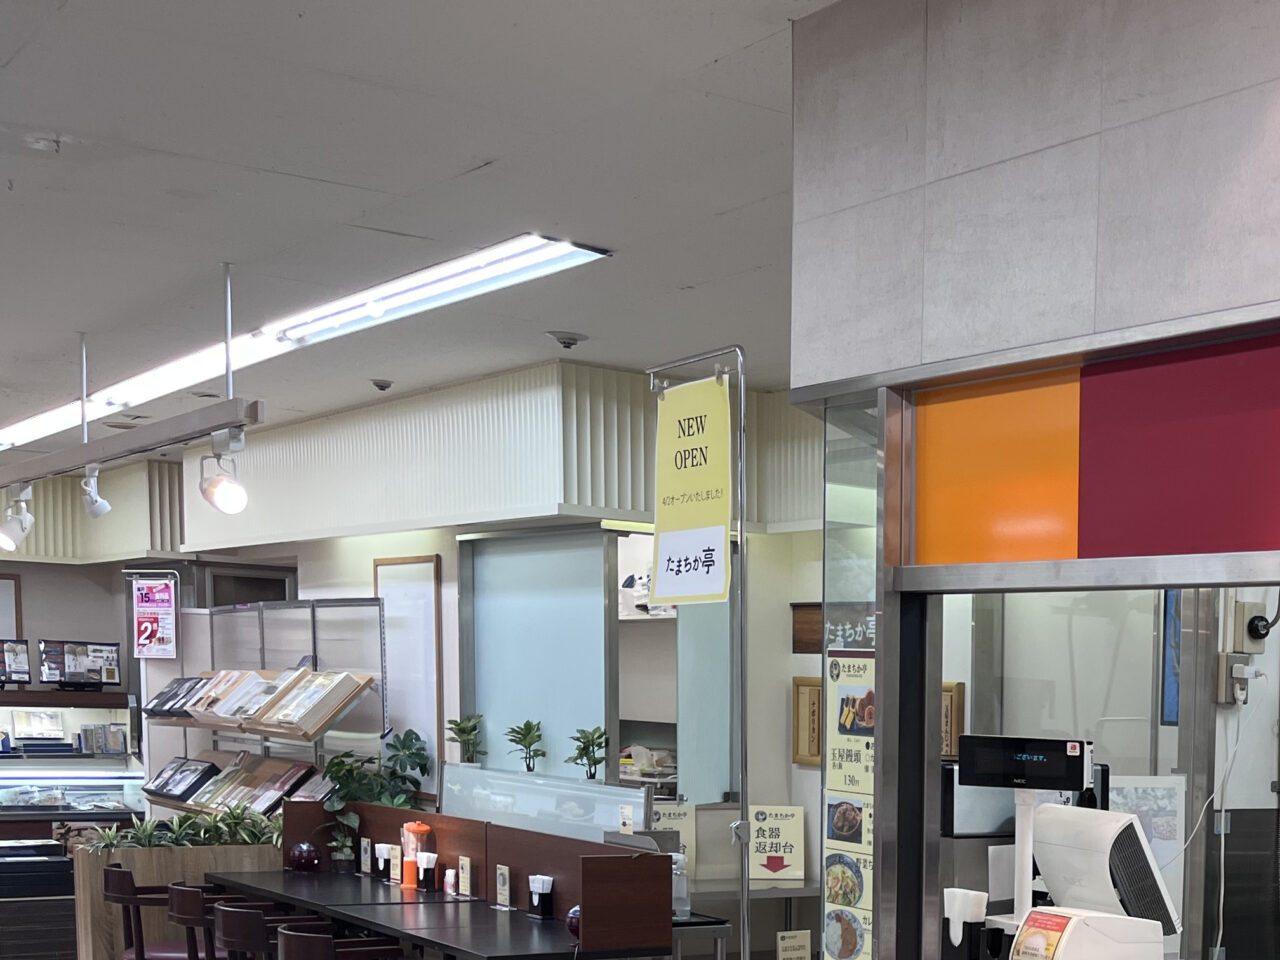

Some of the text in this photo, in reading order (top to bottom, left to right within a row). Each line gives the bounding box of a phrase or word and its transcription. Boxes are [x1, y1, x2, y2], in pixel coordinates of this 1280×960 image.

[677, 414, 707, 438] NEW
[674, 446, 709, 470] OPEN
[665, 546, 716, 576] たまちか亭
[841, 663, 868, 674] たまちか亭
[755, 826, 781, 839] 食器
[754, 841, 795, 854] 返却台
